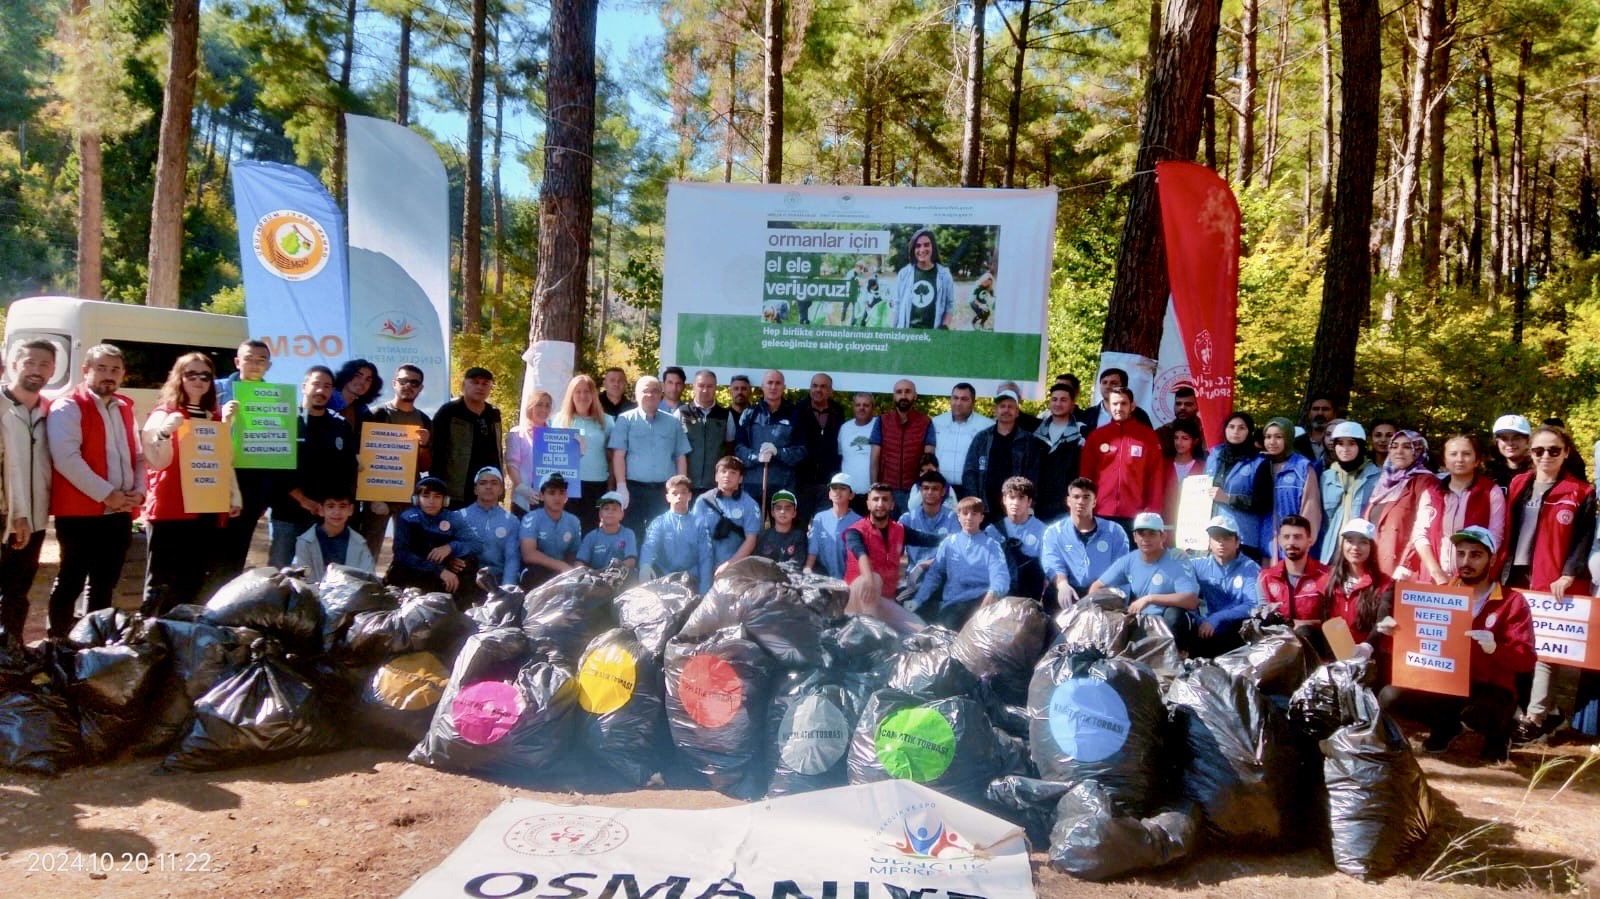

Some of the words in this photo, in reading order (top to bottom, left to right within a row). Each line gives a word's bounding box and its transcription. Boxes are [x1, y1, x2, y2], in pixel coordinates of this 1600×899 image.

[768, 232, 845, 248] ormanlar
[849, 232, 879, 252] için
[766, 255, 782, 273] el
[785, 256, 811, 273] ele
[765, 279, 851, 300] veriyoruz!
[763, 327, 780, 337] Hep
[782, 327, 814, 337] birlikte
[815, 329, 874, 340] ormanlarımızı
[874, 331, 932, 343] temizleyerek,
[761, 338, 818, 349] geleceğimize
[819, 340, 843, 352] sahip
[844, 341, 889, 353] çıkıyoruz!
[1402, 593, 1463, 607] ORMANLAR
[1415, 611, 1449, 622] NEFES
[1418, 627, 1443, 637] ALIR
[1531, 620, 1585, 634] OPLAMA
[1421, 641, 1439, 652] BİZ
[1407, 655, 1453, 670] YAŞARIZ
[919, 801, 937, 809] SPO
